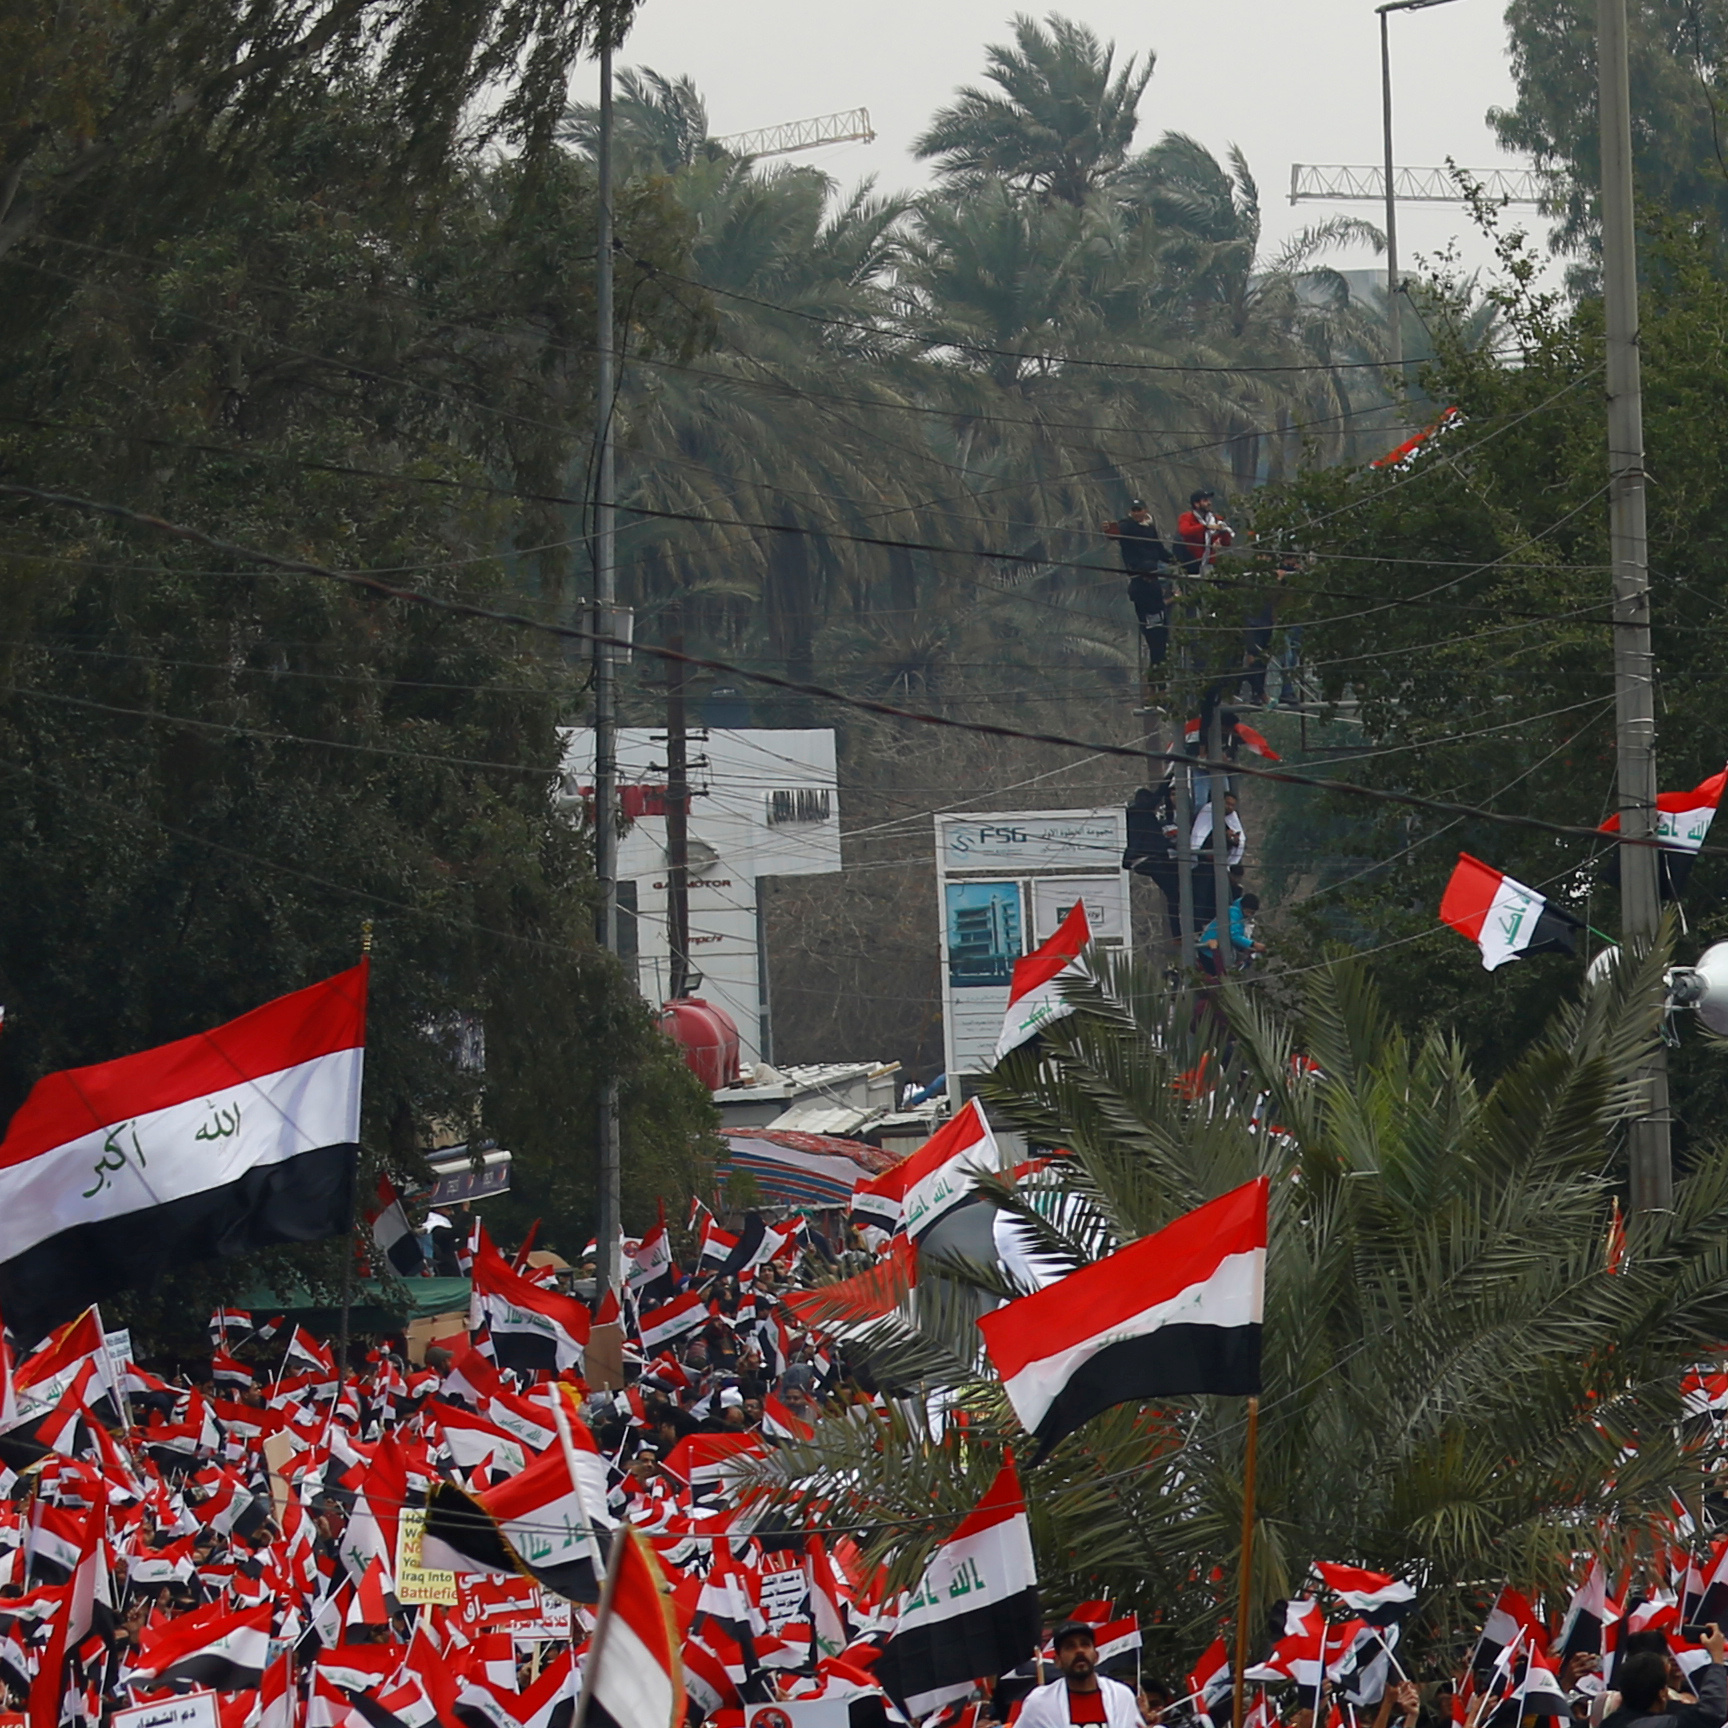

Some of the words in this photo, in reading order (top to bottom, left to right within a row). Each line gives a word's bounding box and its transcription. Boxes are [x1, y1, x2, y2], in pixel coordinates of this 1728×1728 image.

[980, 828, 1026, 844] FSG
[402, 1571, 425, 1584] Iraq
[428, 1571, 452, 1582] Into
[401, 1586, 458, 1599] Battlefie
